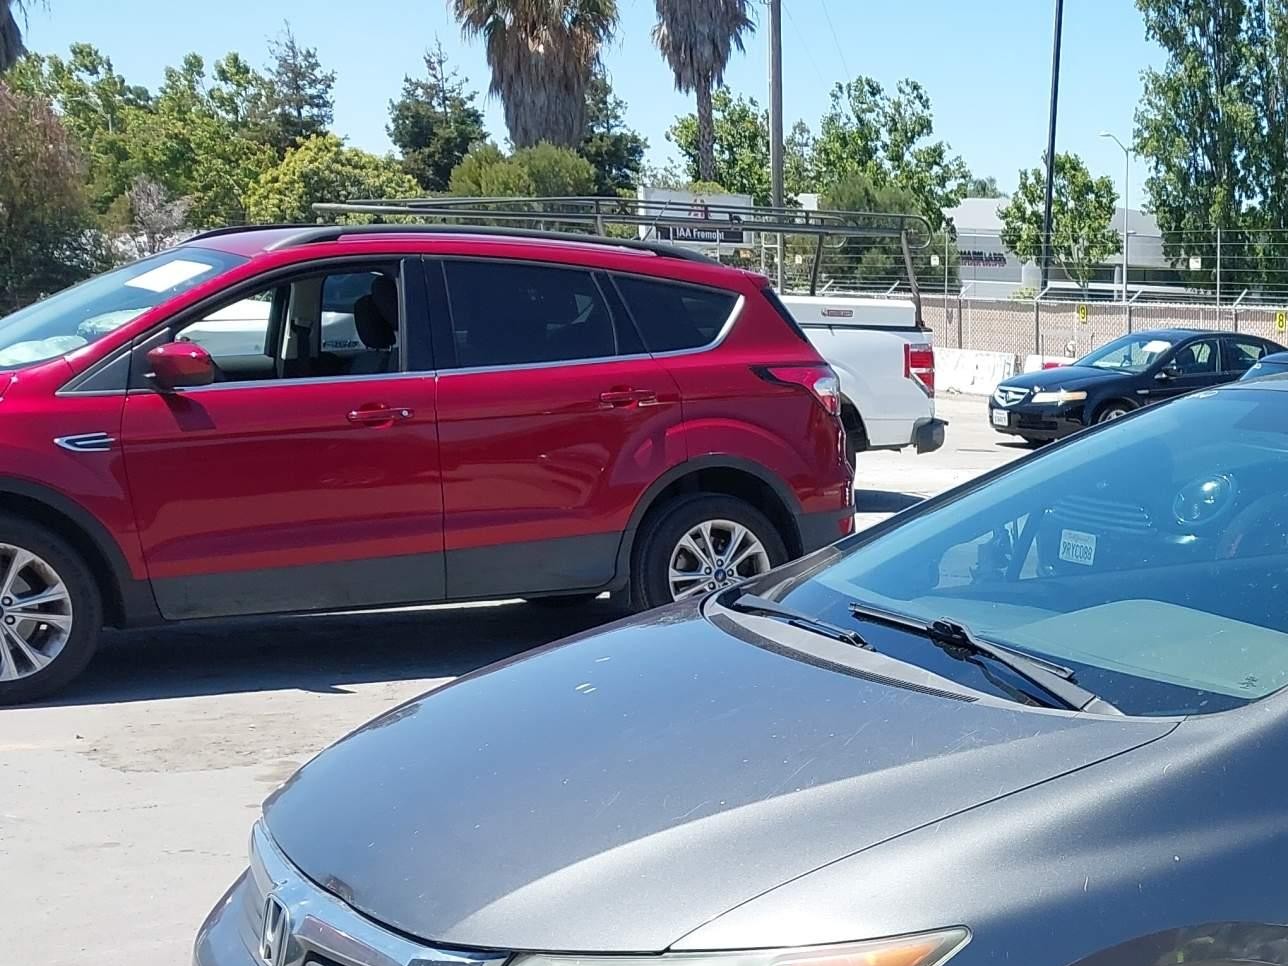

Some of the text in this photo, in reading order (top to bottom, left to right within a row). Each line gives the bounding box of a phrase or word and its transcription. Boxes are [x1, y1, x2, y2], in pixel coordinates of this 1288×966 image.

[676, 226, 691, 239] IAA
[1080, 306, 1086, 320] 9
[1278, 313, 1285, 329] 8
